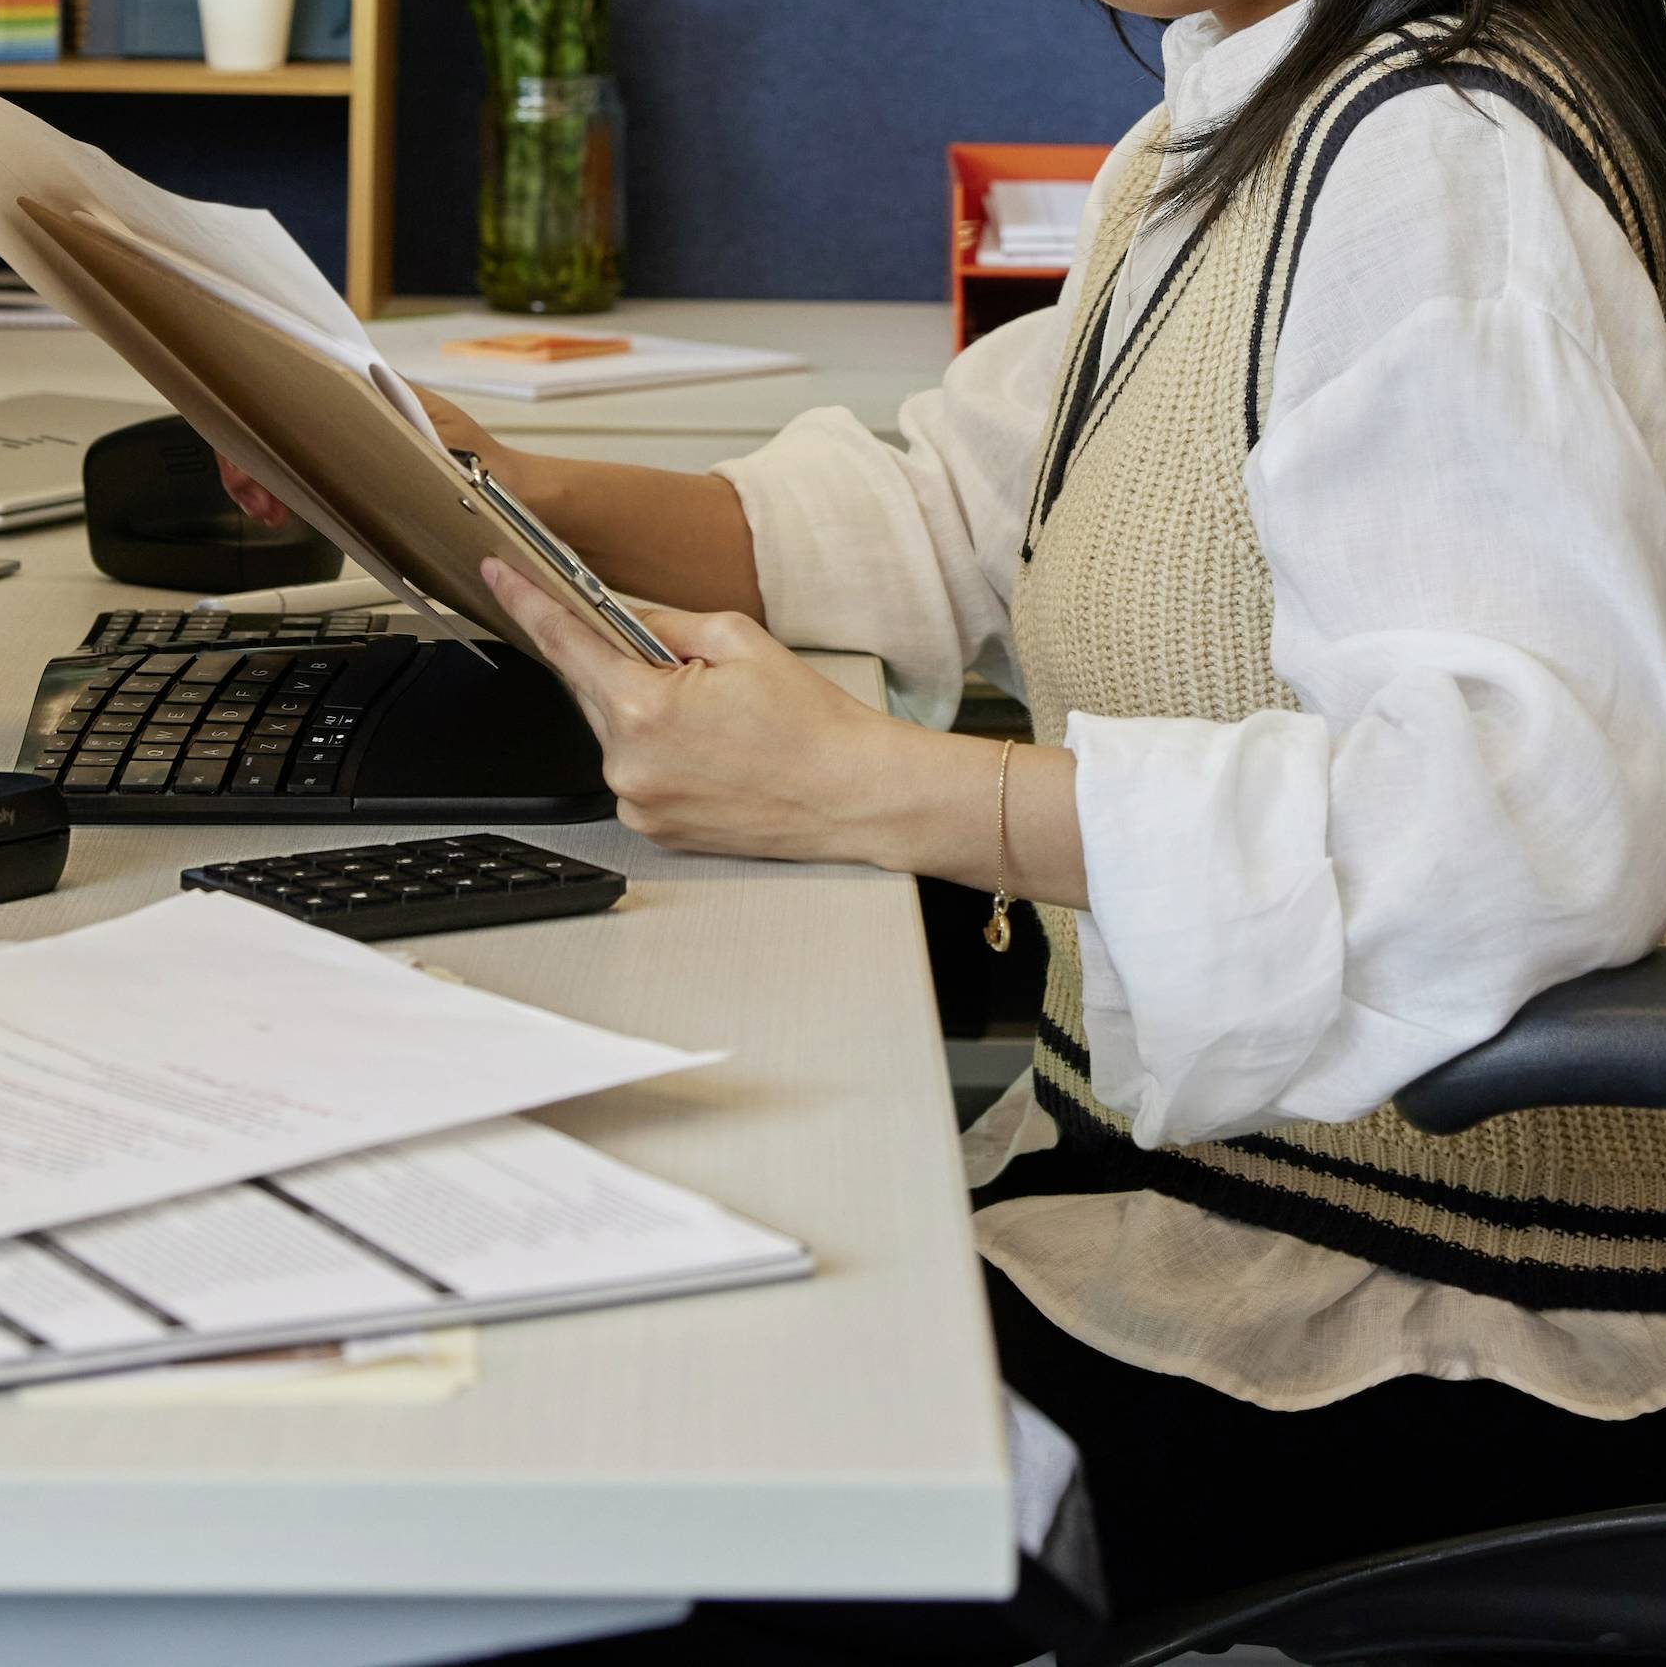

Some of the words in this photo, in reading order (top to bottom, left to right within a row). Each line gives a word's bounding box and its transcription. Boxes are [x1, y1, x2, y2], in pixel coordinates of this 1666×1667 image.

[251, 669, 269, 677] G
[181, 691, 200, 699] R
[235, 690, 251, 698] F
[259, 742, 278, 750] Z
[269, 723, 286, 732] X
[281, 703, 299, 711] C
[293, 681, 310, 689] V
[310, 662, 328, 670] B
[222, 710, 239, 718] D
[155, 730, 174, 740] W
[211, 730, 229, 738] S
[147, 749, 164, 757] Q
[203, 748, 220, 756] A
